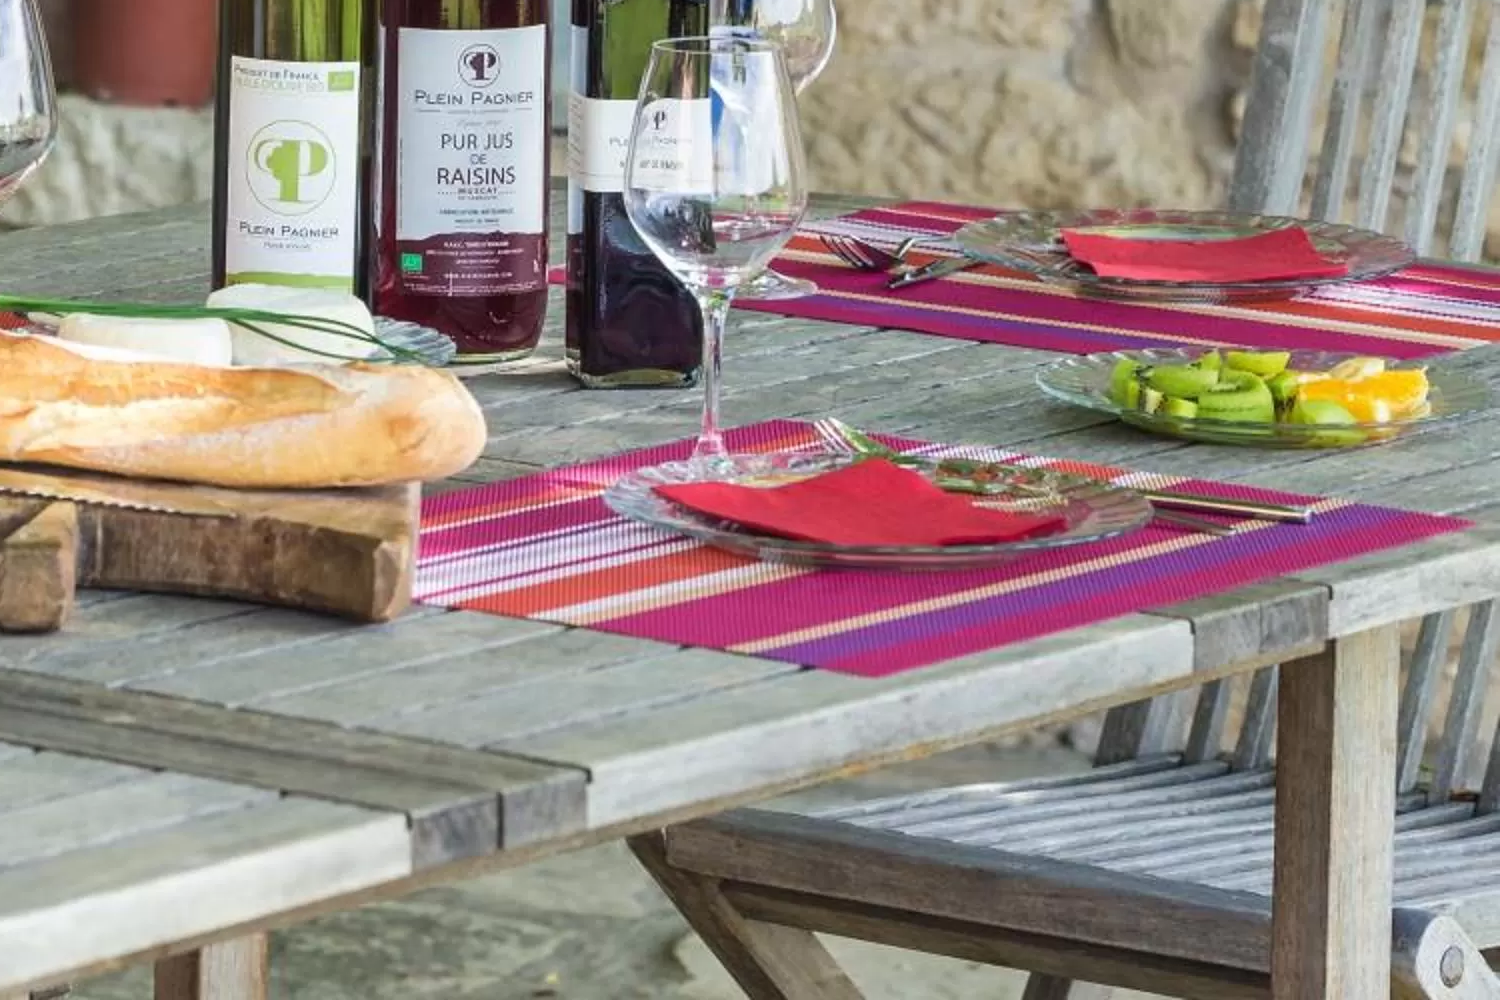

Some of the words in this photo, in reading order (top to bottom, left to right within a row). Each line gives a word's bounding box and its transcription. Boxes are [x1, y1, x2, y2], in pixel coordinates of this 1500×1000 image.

[415, 89, 463, 105] PLEIN
[471, 90, 533, 105] PAGNIER
[440, 132, 477, 150] PUR
[483, 131, 513, 150] JUS
[469, 153, 487, 165] DE
[436, 165, 516, 185] RAISINS
[457, 186, 498, 195] MUSCAT
[239, 220, 274, 236] PLEIN
[281, 224, 339, 238] PAGNIER
